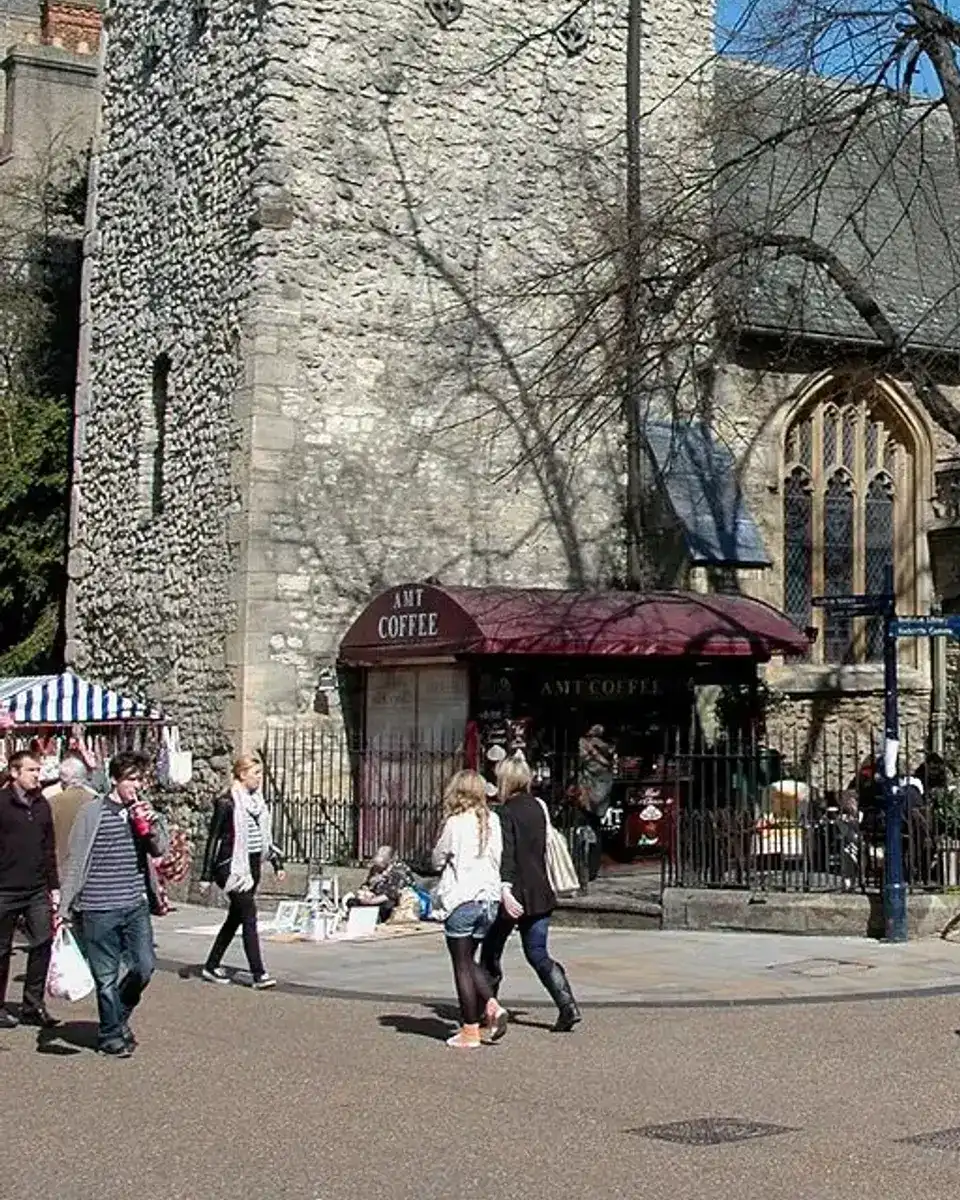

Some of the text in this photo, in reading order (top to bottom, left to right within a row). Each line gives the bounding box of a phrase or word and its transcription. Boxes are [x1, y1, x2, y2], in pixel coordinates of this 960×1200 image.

[393, 588, 424, 609] AMT
[378, 613, 438, 639] COFFEE
[540, 676, 663, 697] AMT COFFEE
